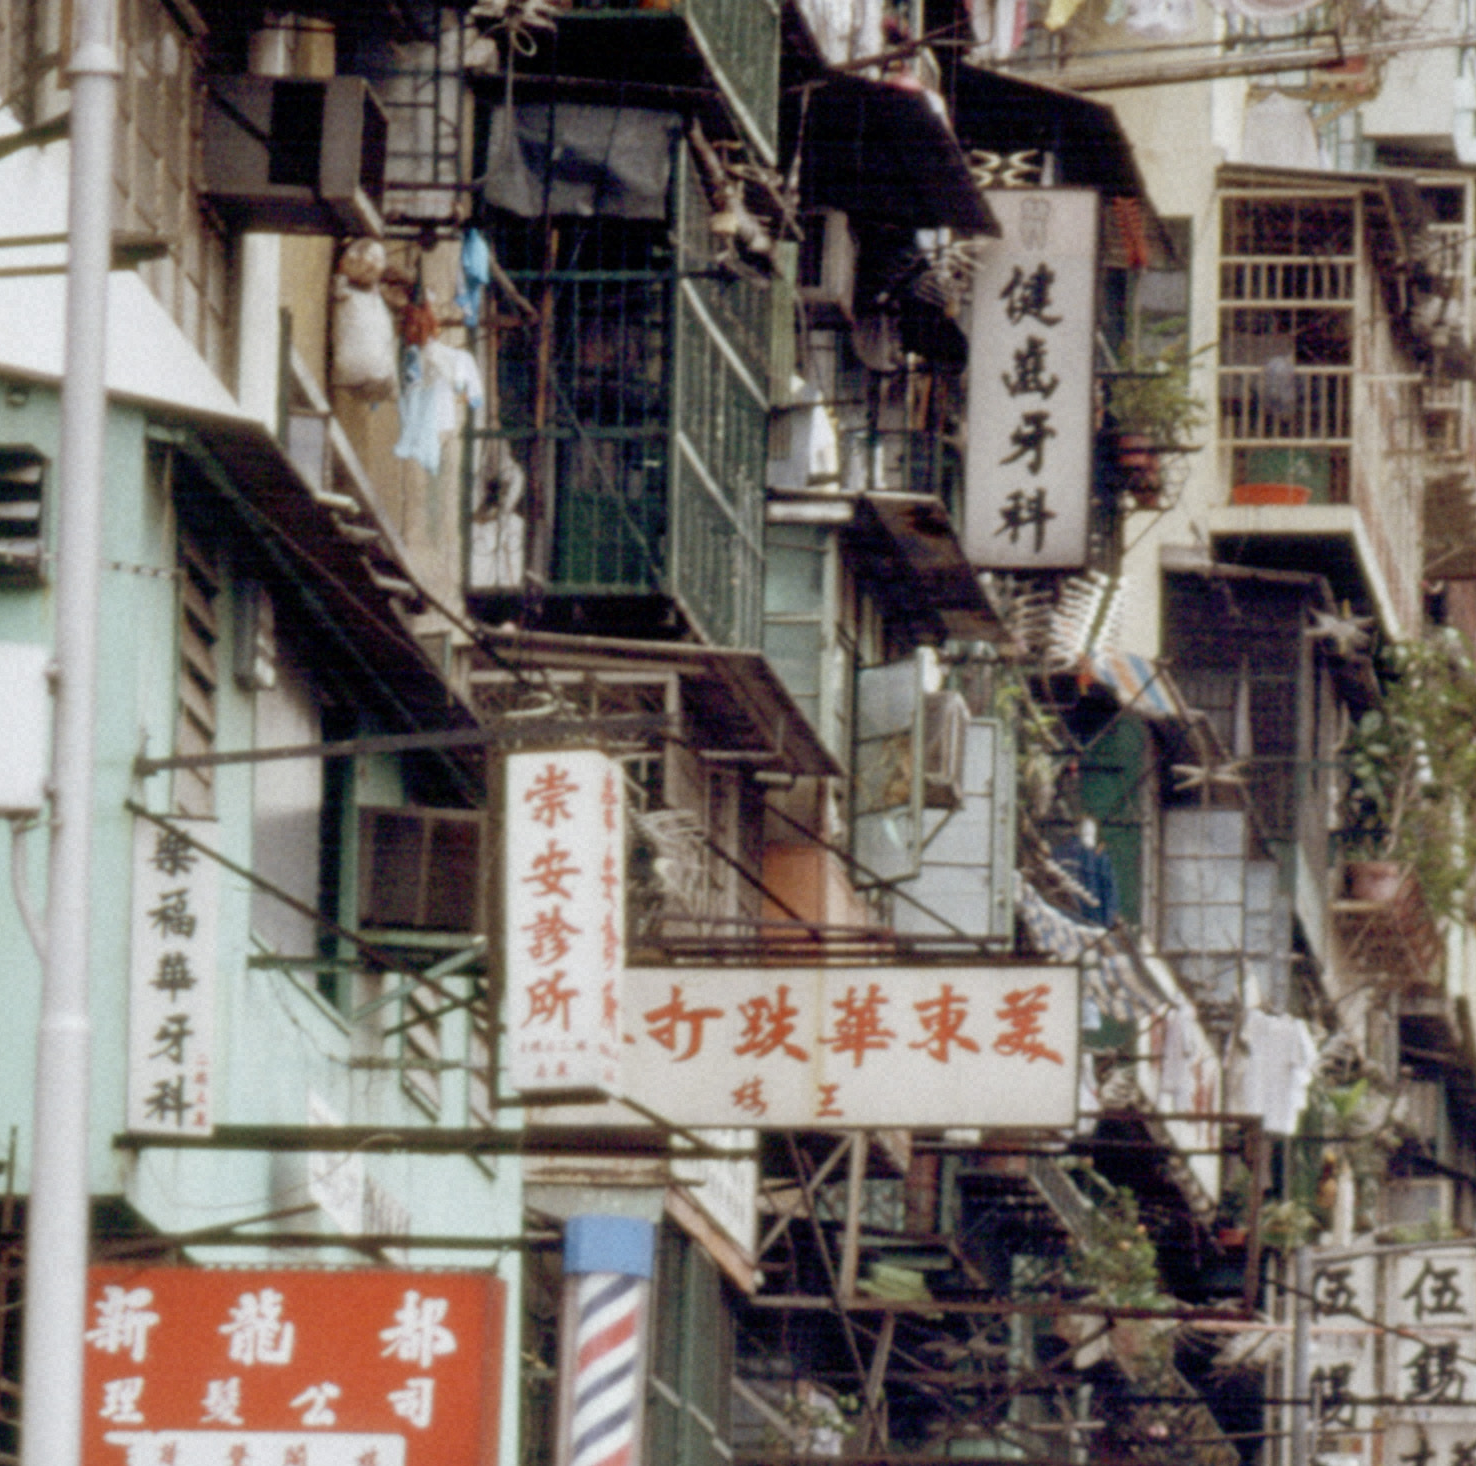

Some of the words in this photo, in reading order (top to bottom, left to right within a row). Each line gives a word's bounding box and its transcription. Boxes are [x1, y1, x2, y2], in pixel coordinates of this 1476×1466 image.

[521, 763, 582, 1032] 崇安診所
[85, 1284, 458, 1369] 新龍都
[98, 1375, 437, 1429] 理髮公司
